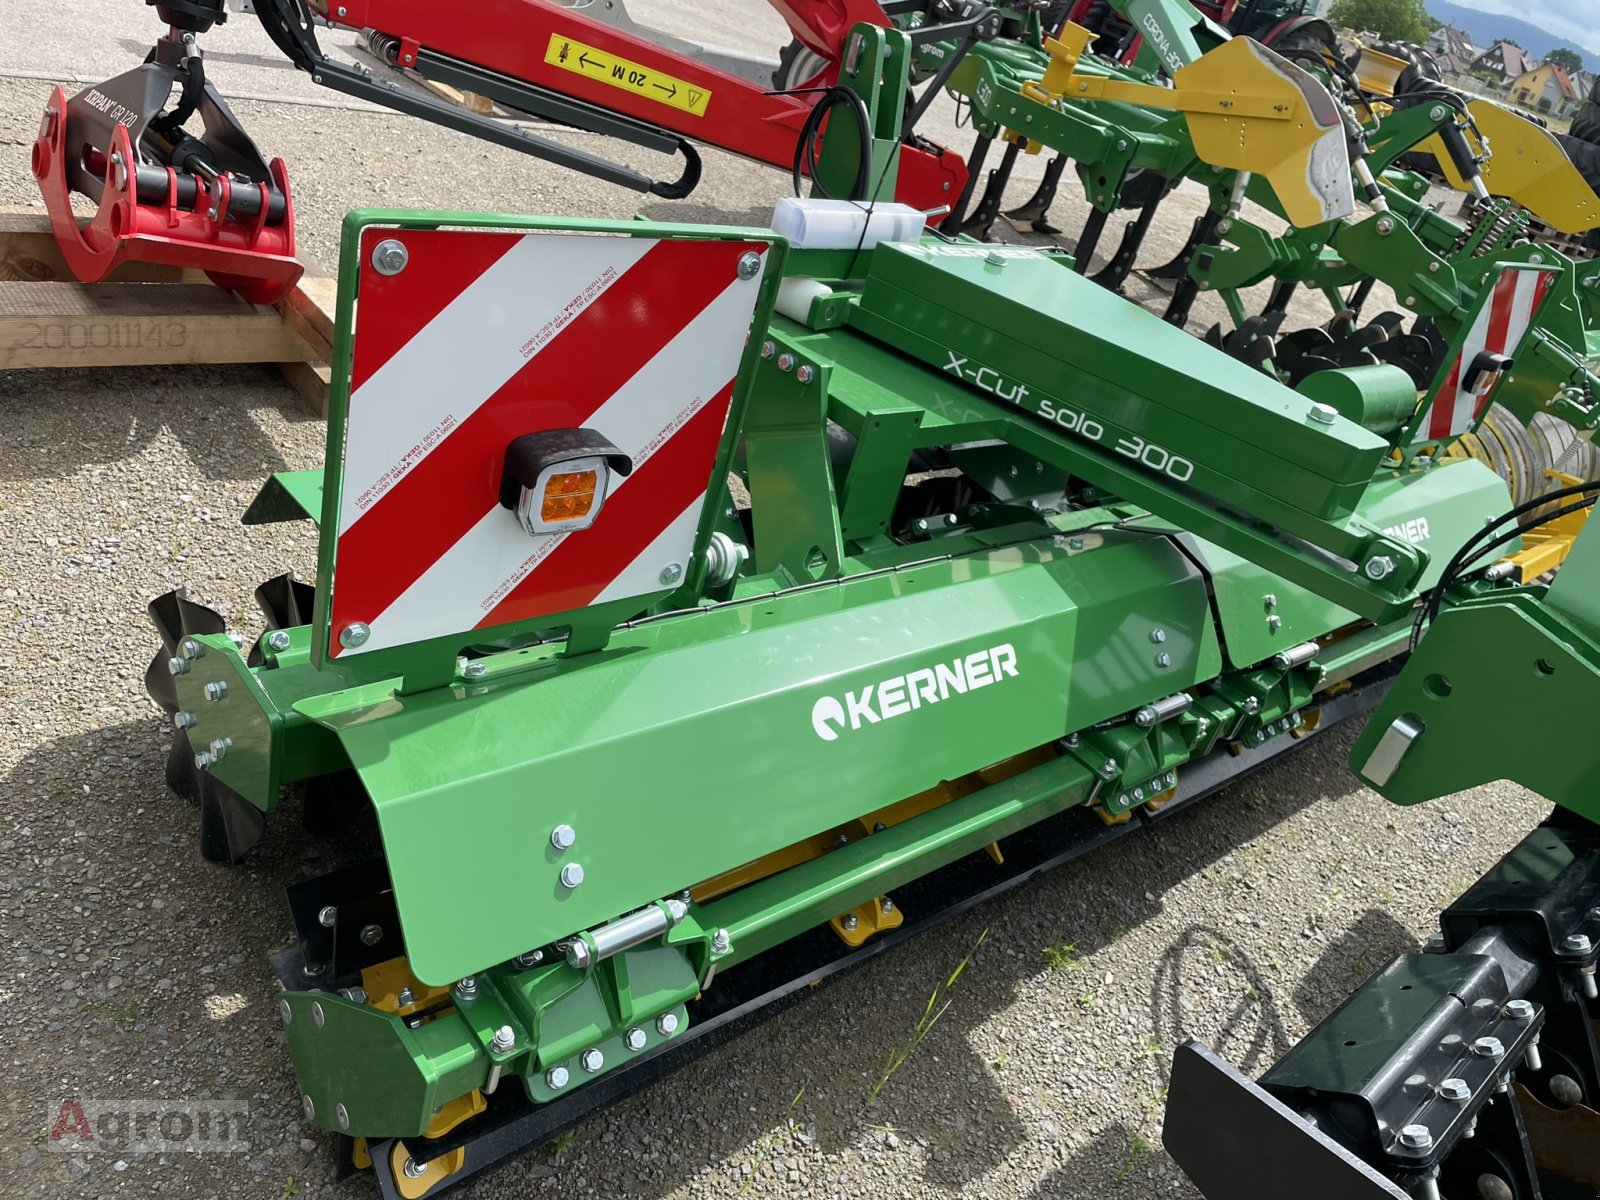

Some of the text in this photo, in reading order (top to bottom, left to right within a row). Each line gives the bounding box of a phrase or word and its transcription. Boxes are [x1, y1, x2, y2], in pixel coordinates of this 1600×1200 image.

[1143, 13, 1170, 56] CORONA
[612, 64, 647, 87] 20 M
[84, 89, 138, 128] KRPAN GR 120
[602, 266, 614, 278] DIN
[586, 278, 602, 293] 11030
[564, 295, 582, 311] GEKA
[523, 347, 535, 358] DIN
[535, 331, 552, 346] 11030
[556, 312, 574, 329] GEKA
[584, 286, 602, 302] ESC-A
[601, 270, 617, 286] 06021
[553, 315, 561, 323] TP
[20, 323, 188, 350] 200011143
[535, 321, 552, 338] ESC-A
[519, 338, 535, 353] 06021
[441, 414, 453, 426] DIN
[943, 351, 1029, 404] X-Cut
[1037, 400, 1103, 441] solo
[1115, 436, 1194, 482] 300
[424, 426, 440, 442] 11030
[402, 445, 420, 462] GEKA
[360, 498, 372, 510] DIN
[372, 482, 390, 498] 11030
[393, 462, 412, 479] GEKA
[415, 450, 423, 458] TP
[424, 434, 441, 451] ESC-A
[440, 418, 458, 434] 06021
[391, 466, 398, 474] TP
[372, 473, 390, 490] ESC-A
[355, 490, 371, 506] 06021
[553, 532, 565, 545] 0602
[845, 643, 1019, 730] KERNER
